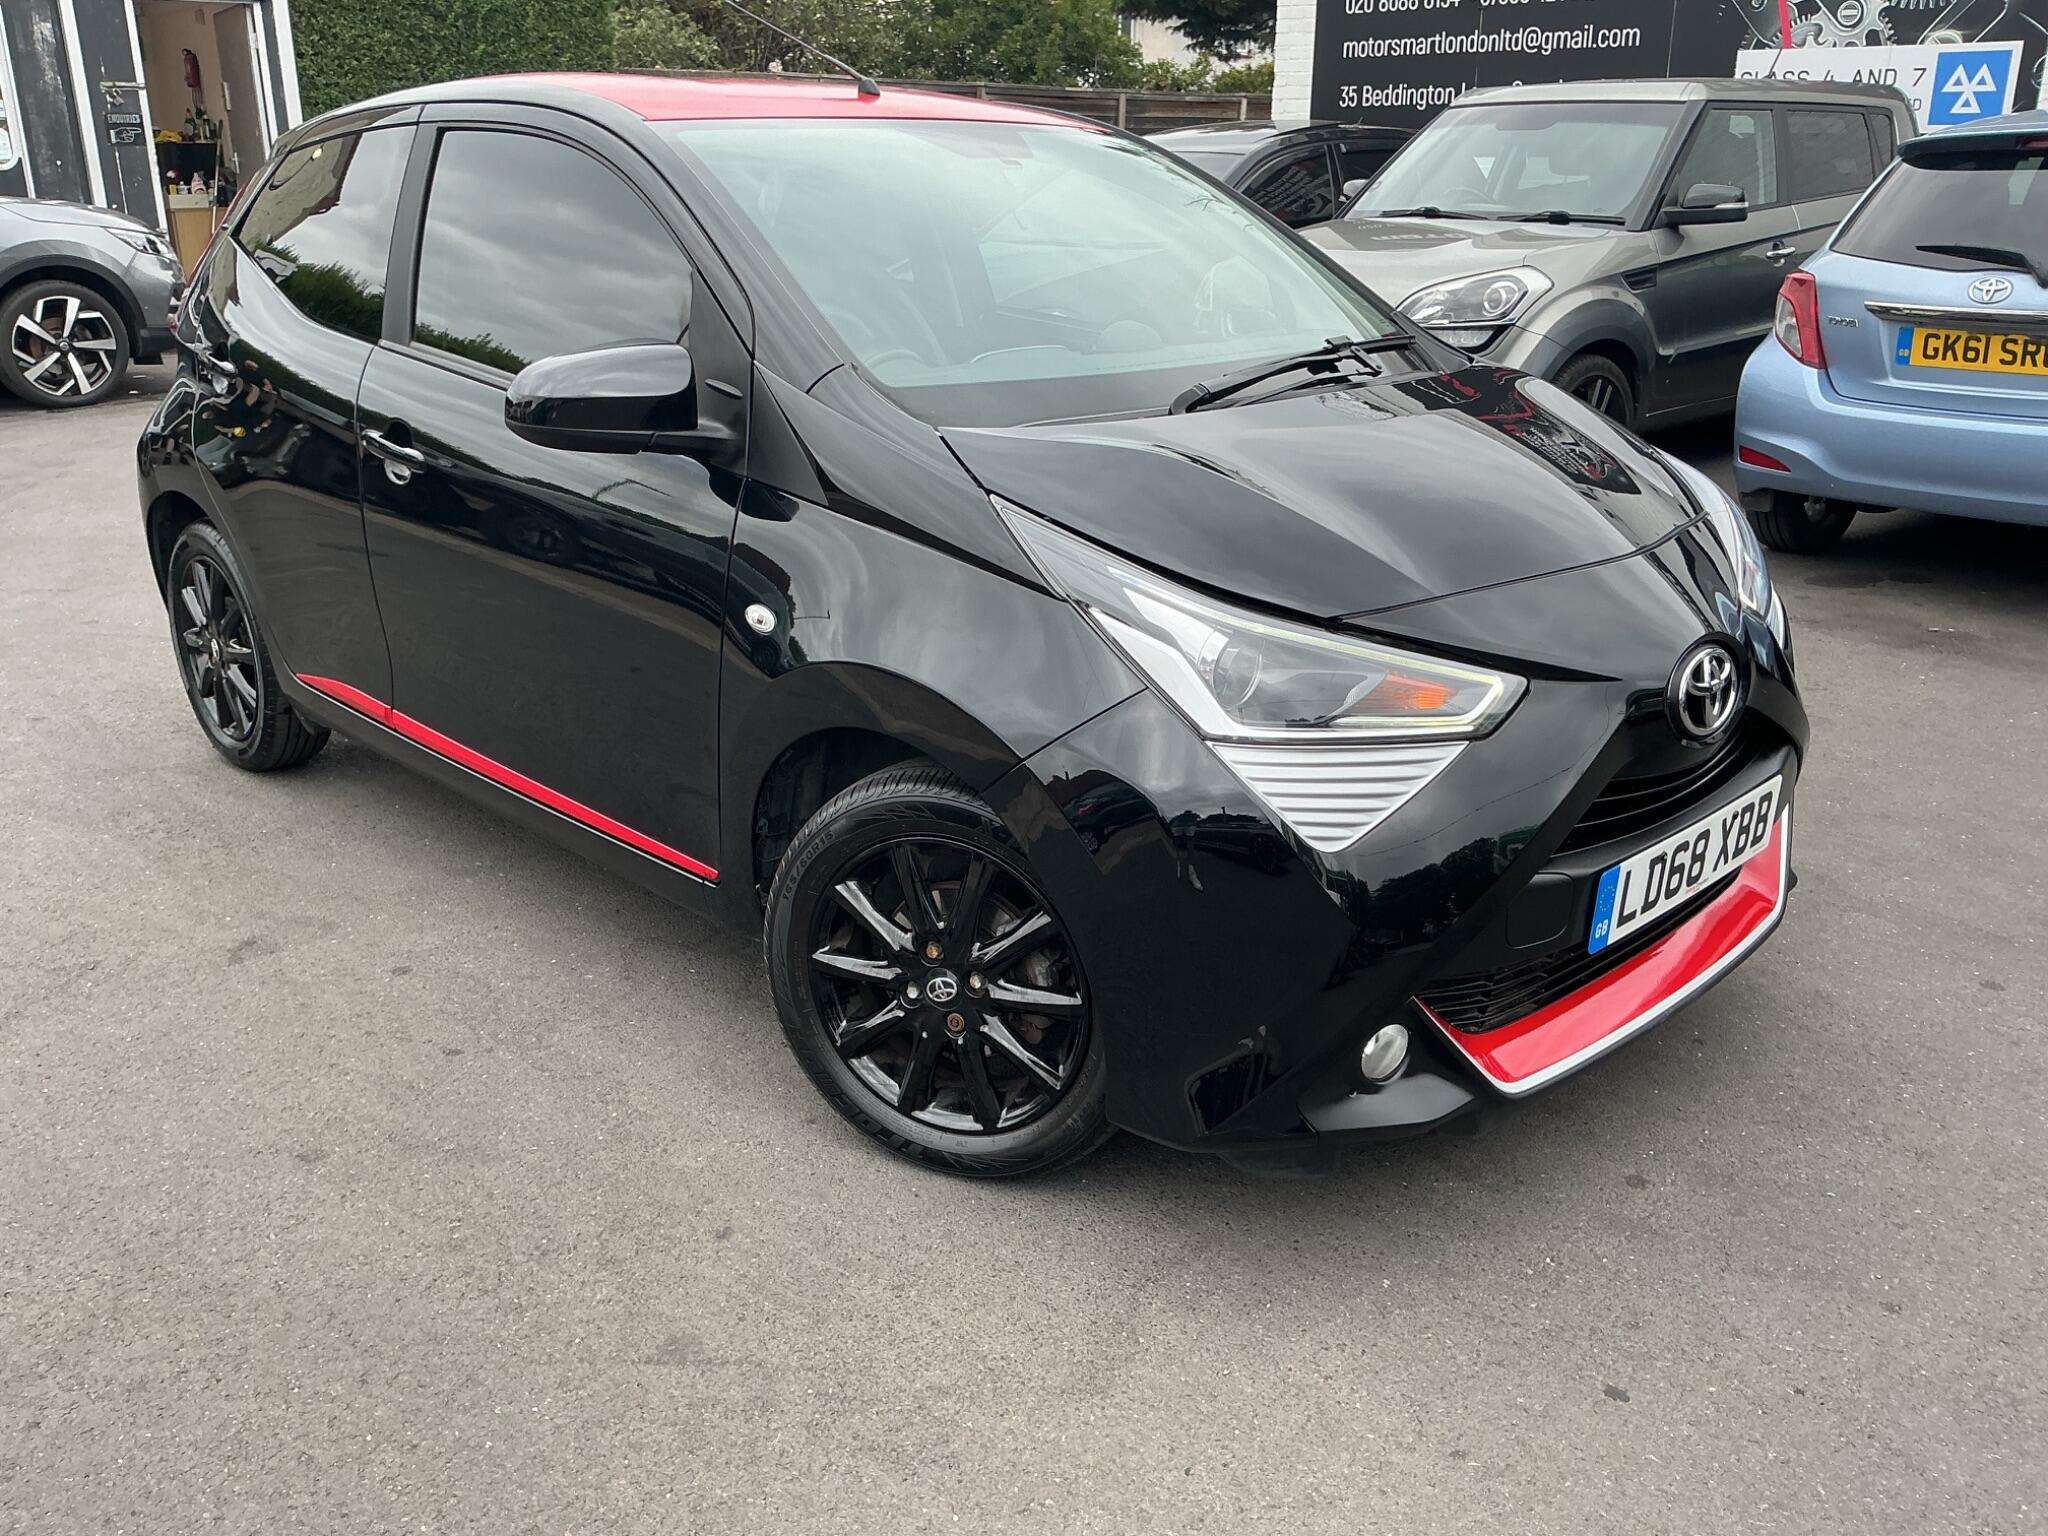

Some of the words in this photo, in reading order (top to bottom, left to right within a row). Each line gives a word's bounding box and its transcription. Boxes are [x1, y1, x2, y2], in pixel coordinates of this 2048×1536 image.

[1342, 24, 1640, 58] motorsmartlondonltd@gmail.com
[1852, 67, 1897, 86] AND
[1912, 67, 1927, 87] 7
[1339, 85, 1358, 108] 35
[1361, 83, 1455, 111] Beddington
[1921, 332, 1991, 365] GK61
[1616, 828, 1711, 929] LD68
[1713, 790, 1774, 873] XBB
[1594, 918, 1609, 940] GB
